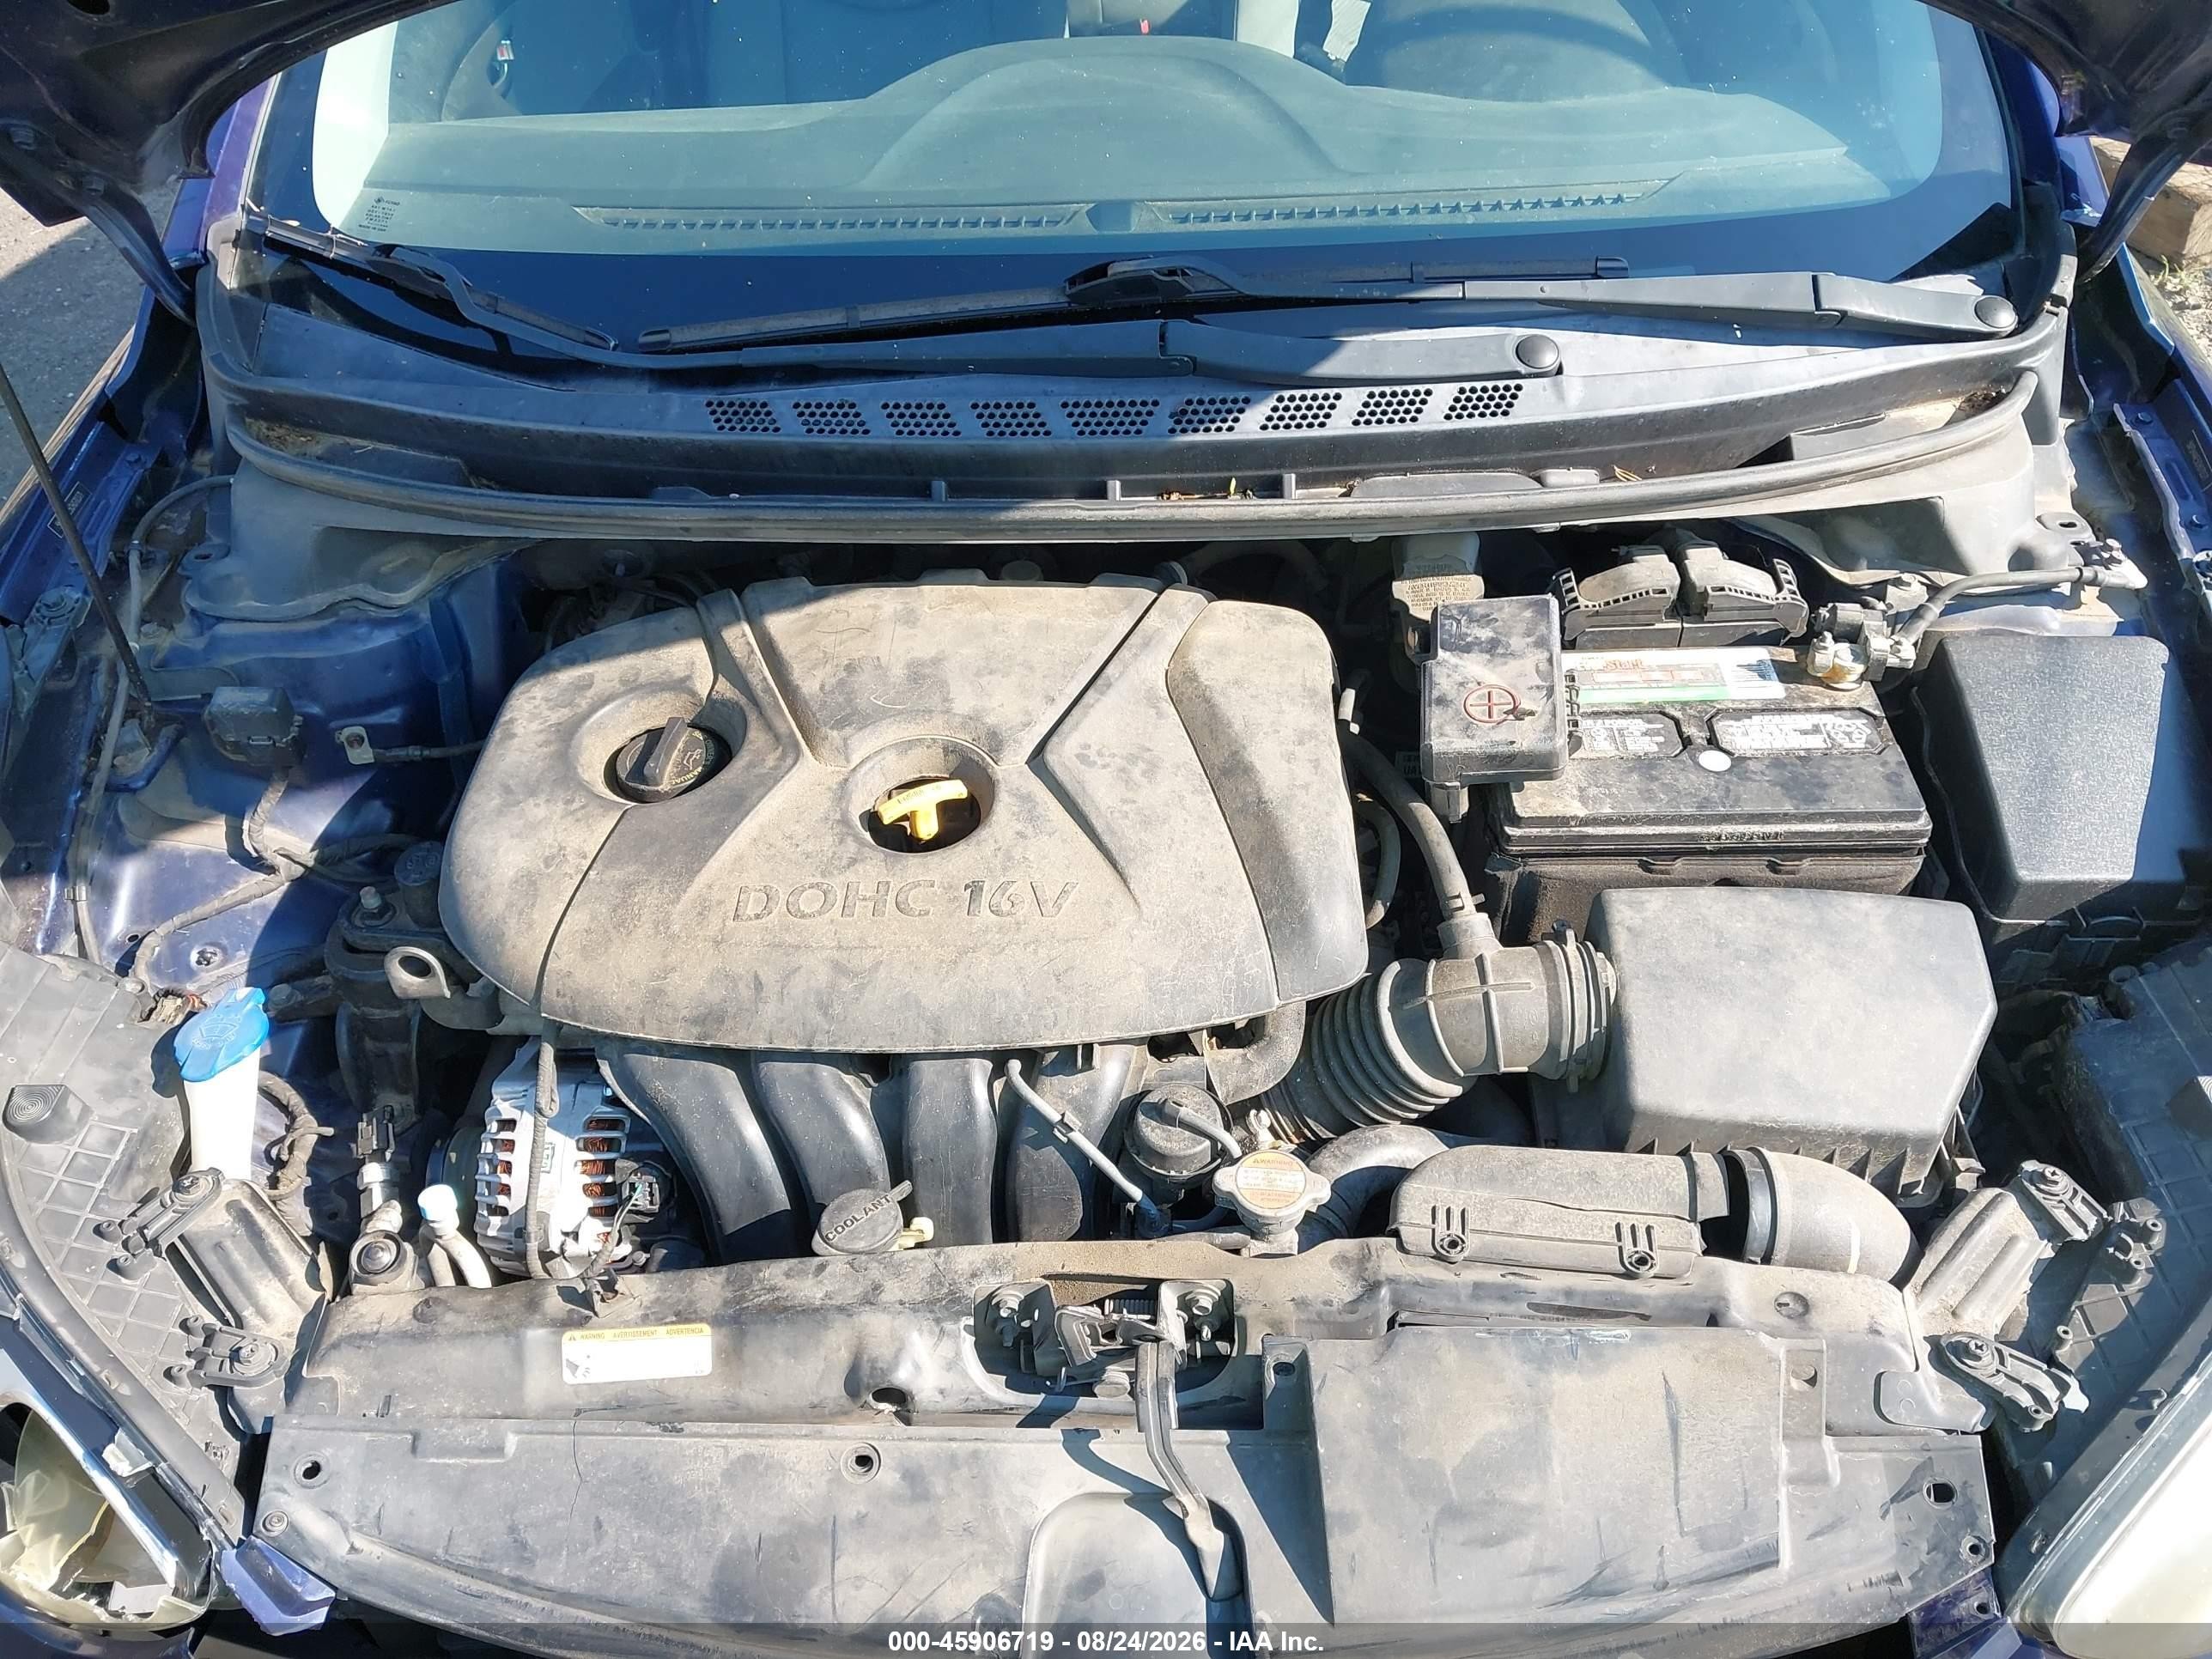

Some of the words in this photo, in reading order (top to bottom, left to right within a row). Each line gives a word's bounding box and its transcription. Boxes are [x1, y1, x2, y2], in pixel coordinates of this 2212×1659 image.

[672, 766, 703, 785] MANUAL
[732, 879, 936, 922] DOHC
[963, 879, 1079, 919] 16V
[824, 1194, 891, 1242] COOLANT
[580, 1332, 605, 1340] WARNING
[613, 1329, 658, 1339] AVERTISSEMENT
[666, 1327, 704, 1336] ADVERTENCIA
